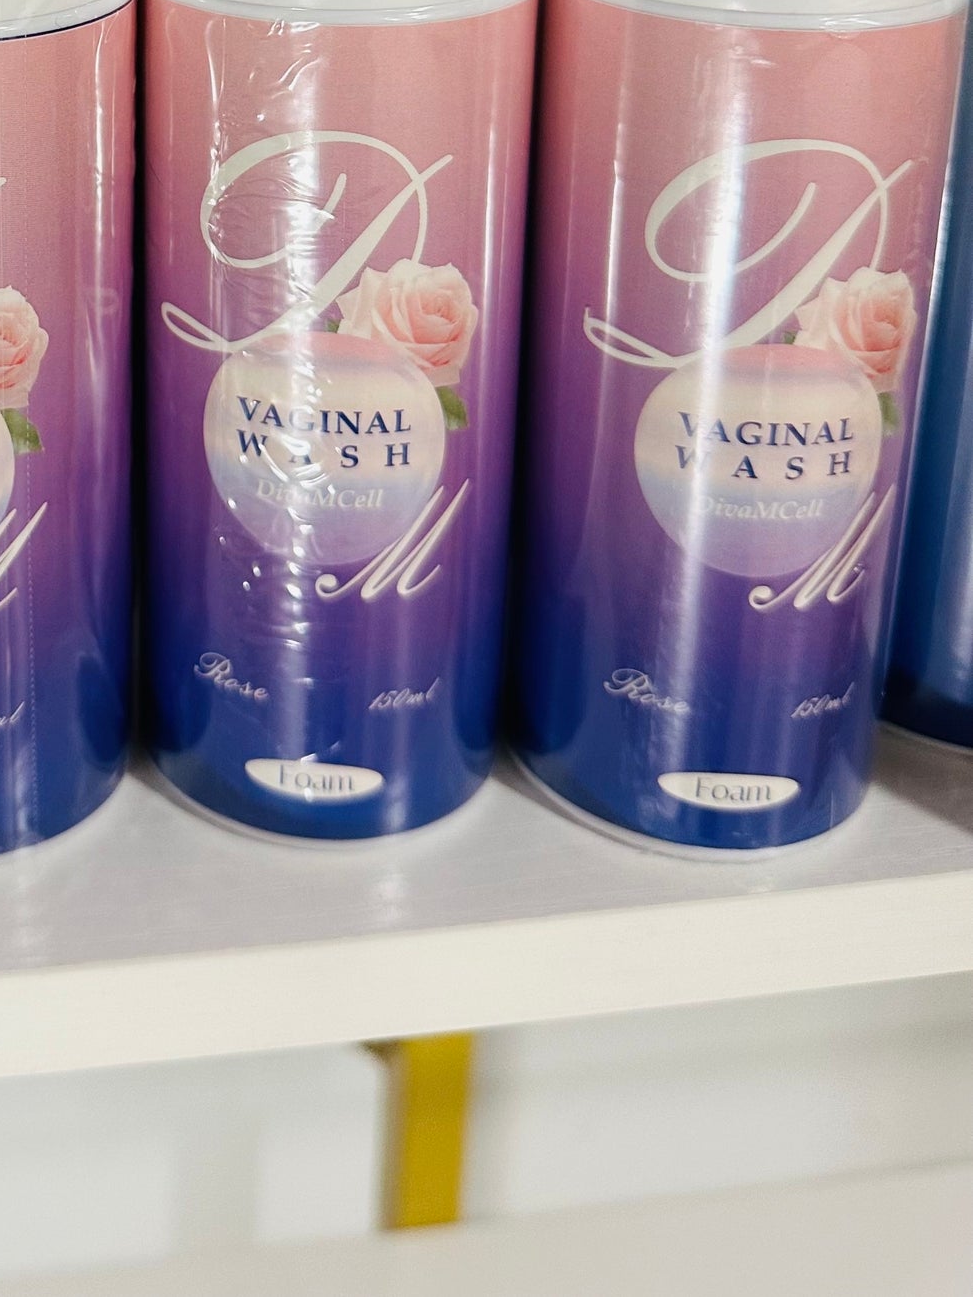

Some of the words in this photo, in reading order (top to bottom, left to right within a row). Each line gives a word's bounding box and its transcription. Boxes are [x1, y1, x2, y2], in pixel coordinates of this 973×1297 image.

[235, 395, 413, 435] VAGINAL
[678, 410, 855, 447] VAGINAL
[315, 477, 470, 599] M
[748, 483, 897, 611] M
[193, 651, 270, 703] Rose
[367, 675, 441, 712] 150ml
[602, 667, 691, 716] Rose
[279, 763, 356, 792] Foam
[695, 775, 772, 804] Foam
